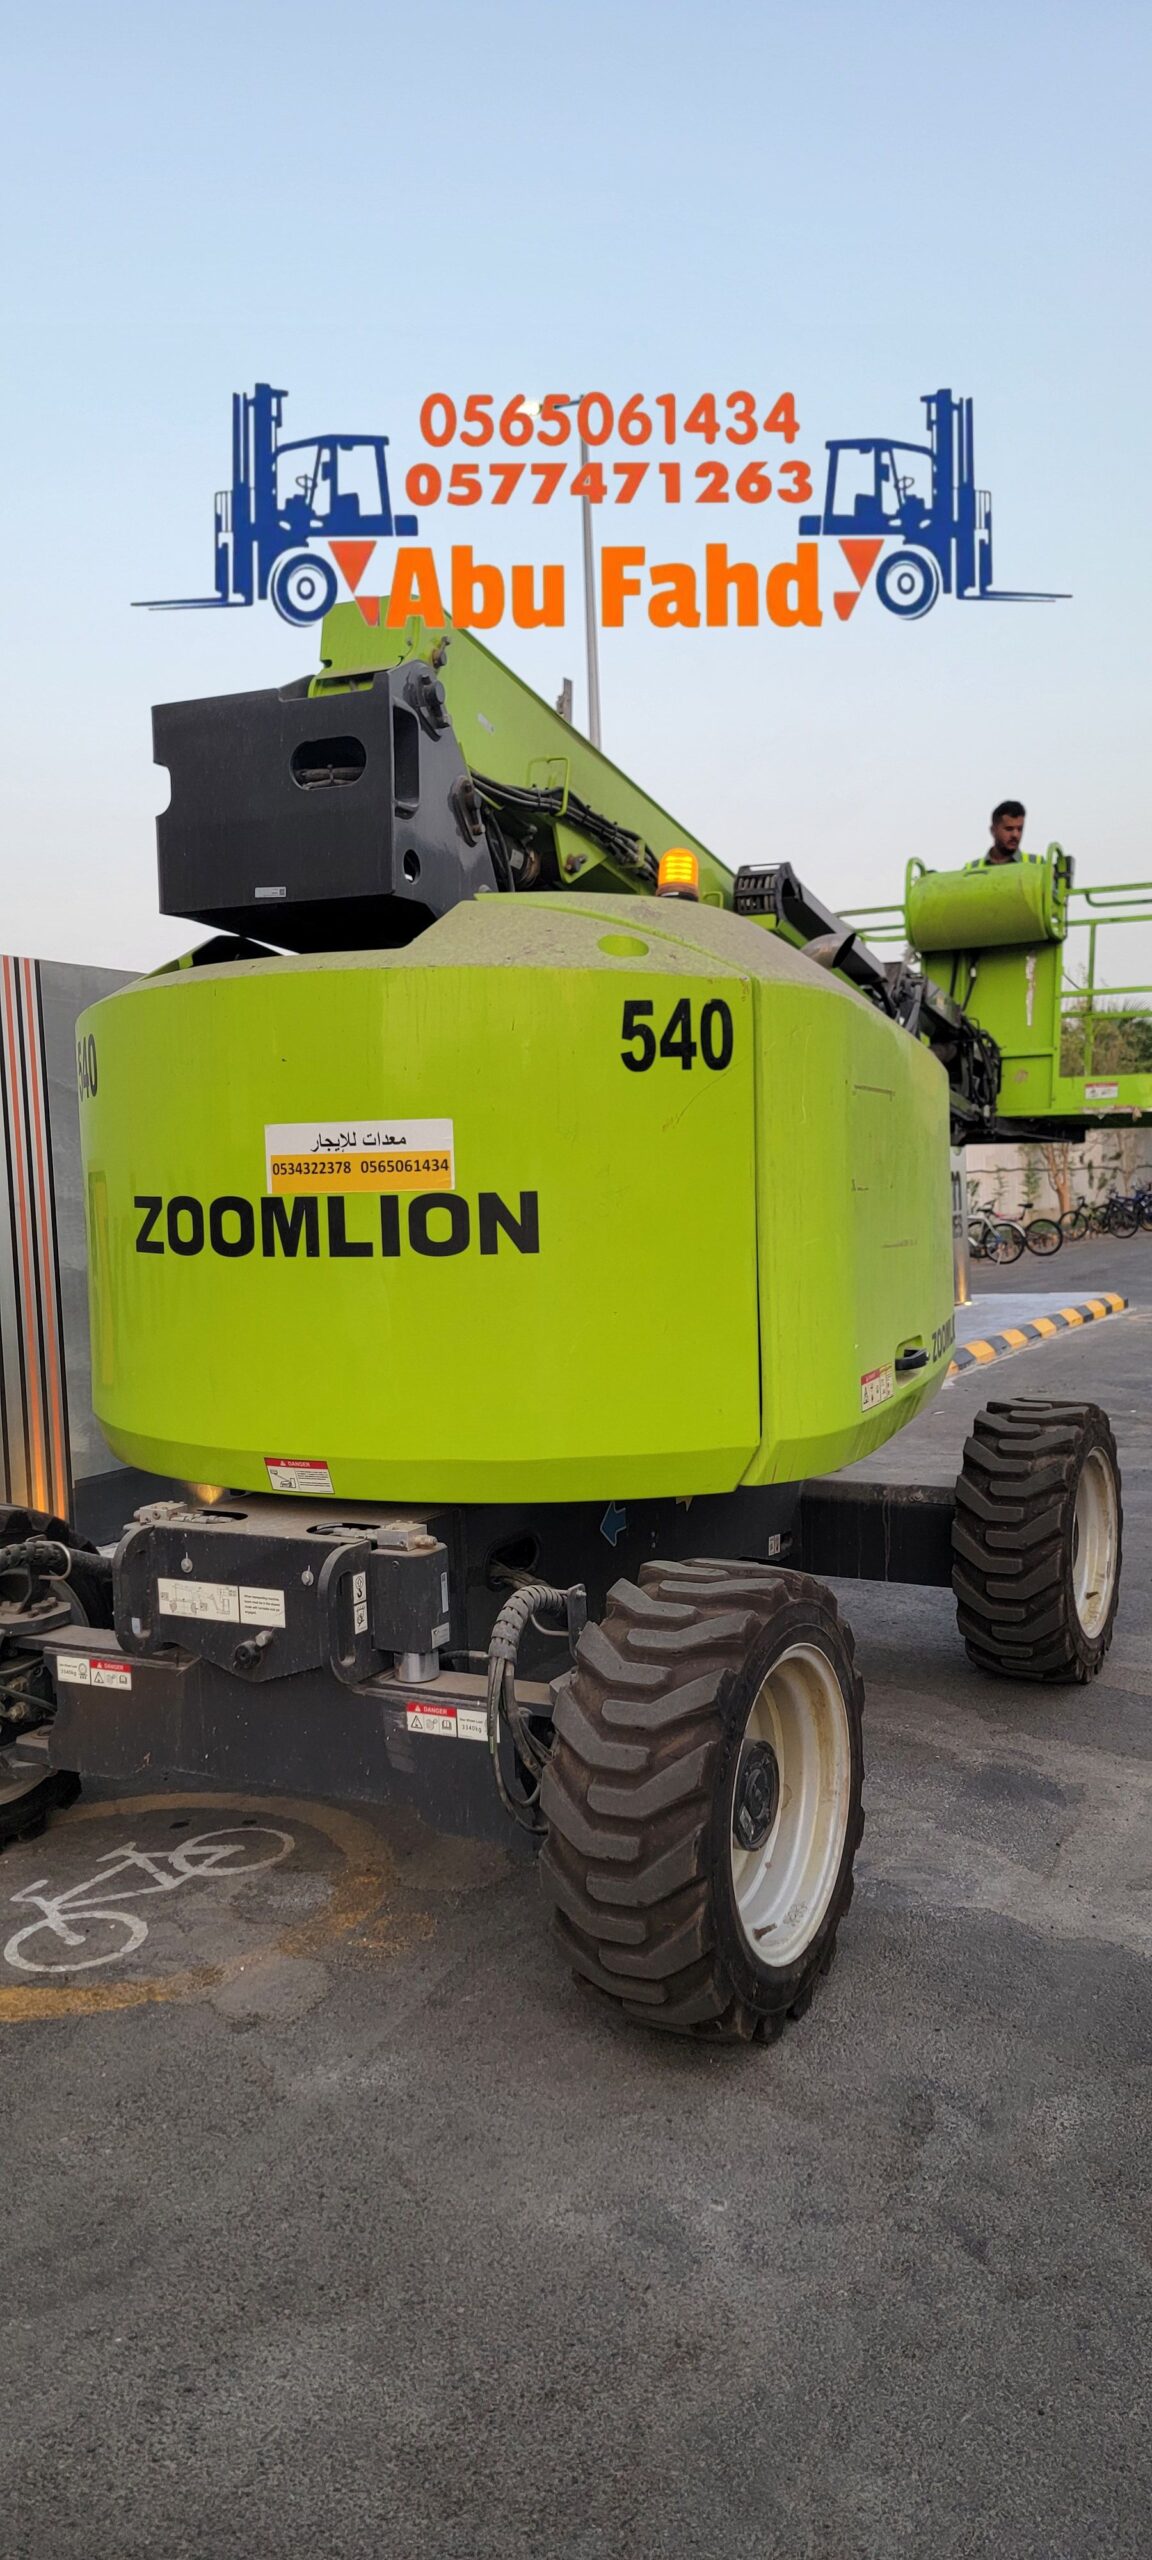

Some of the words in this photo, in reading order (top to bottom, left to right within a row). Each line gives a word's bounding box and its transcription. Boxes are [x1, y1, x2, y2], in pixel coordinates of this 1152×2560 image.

[620, 997, 734, 1073] 540
[311, 1131, 357, 1153] للإيجار
[362, 1132, 407, 1147] معدات
[272, 1160, 352, 1176] 0534322378
[360, 1158, 450, 1174] 0565061434
[133, 1190, 540, 1258] ZOOMLION
[287, 1460, 311, 1468] DANGER
[423, 1706, 448, 1715] DANGER
